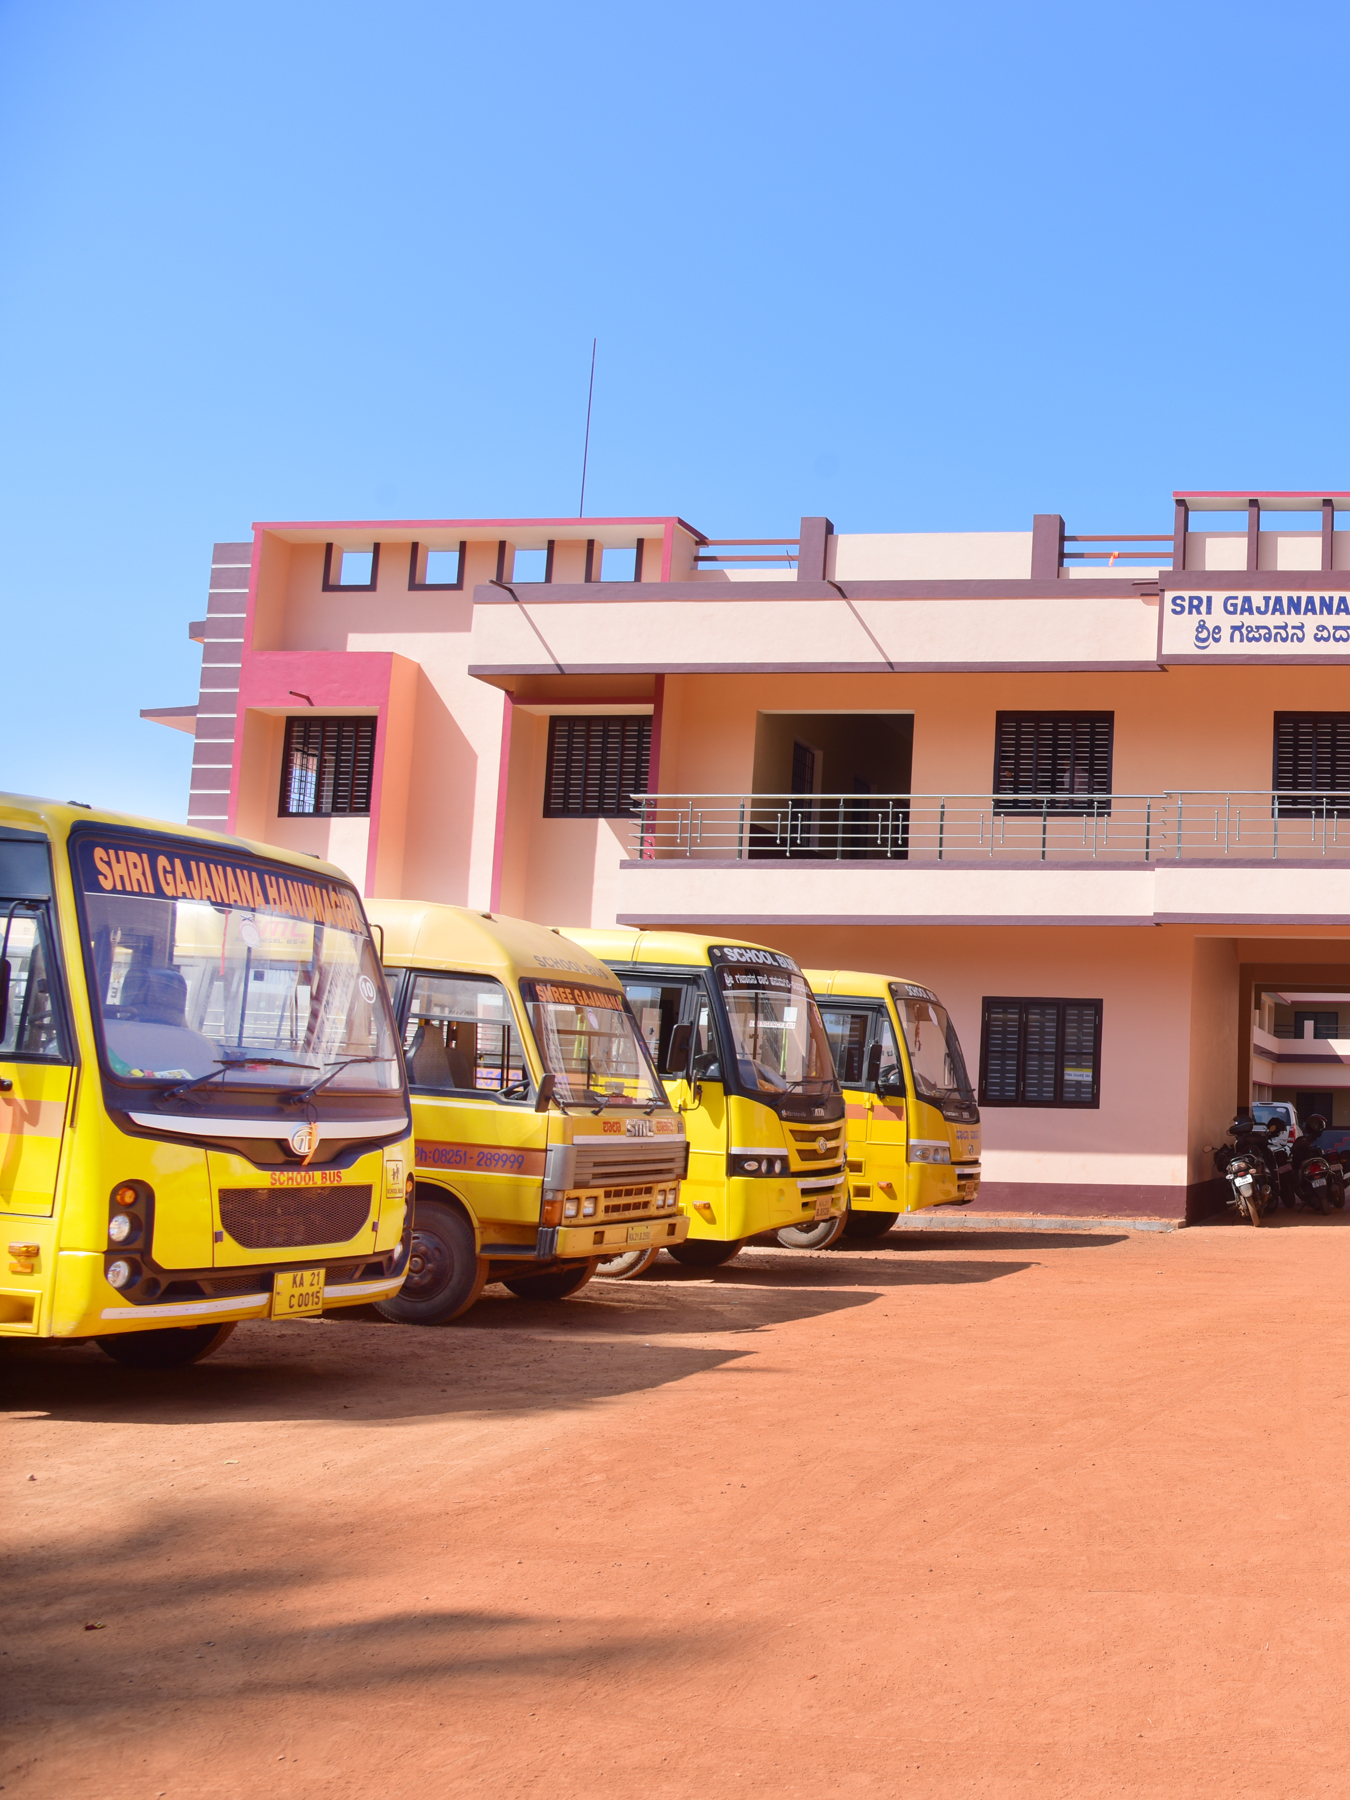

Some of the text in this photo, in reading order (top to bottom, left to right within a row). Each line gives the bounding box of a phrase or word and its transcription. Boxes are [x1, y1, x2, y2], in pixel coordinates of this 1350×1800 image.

[1171, 595, 1213, 616] SRI
[1223, 595, 1350, 616] GAJANANA
[1193, 619, 1222, 650] ಶ್ರೀ
[1229, 620, 1305, 643] ಗಜಾನನ
[93, 847, 362, 932] SHRI GAJANANA HANUMAGIRI
[533, 955, 609, 980] SCHOOL BUS
[723, 947, 798, 971] SCHOOL BUS
[362, 981, 374, 998] 10
[535, 984, 625, 1012] SHREE GAJANANA
[905, 985, 929, 999] SCHOOL
[476, 1151, 525, 1169] 289999
[270, 1170, 342, 1186] SCHOOL BUS
[292, 1271, 320, 1288] KA 21
[289, 1291, 321, 1309] C 0015
